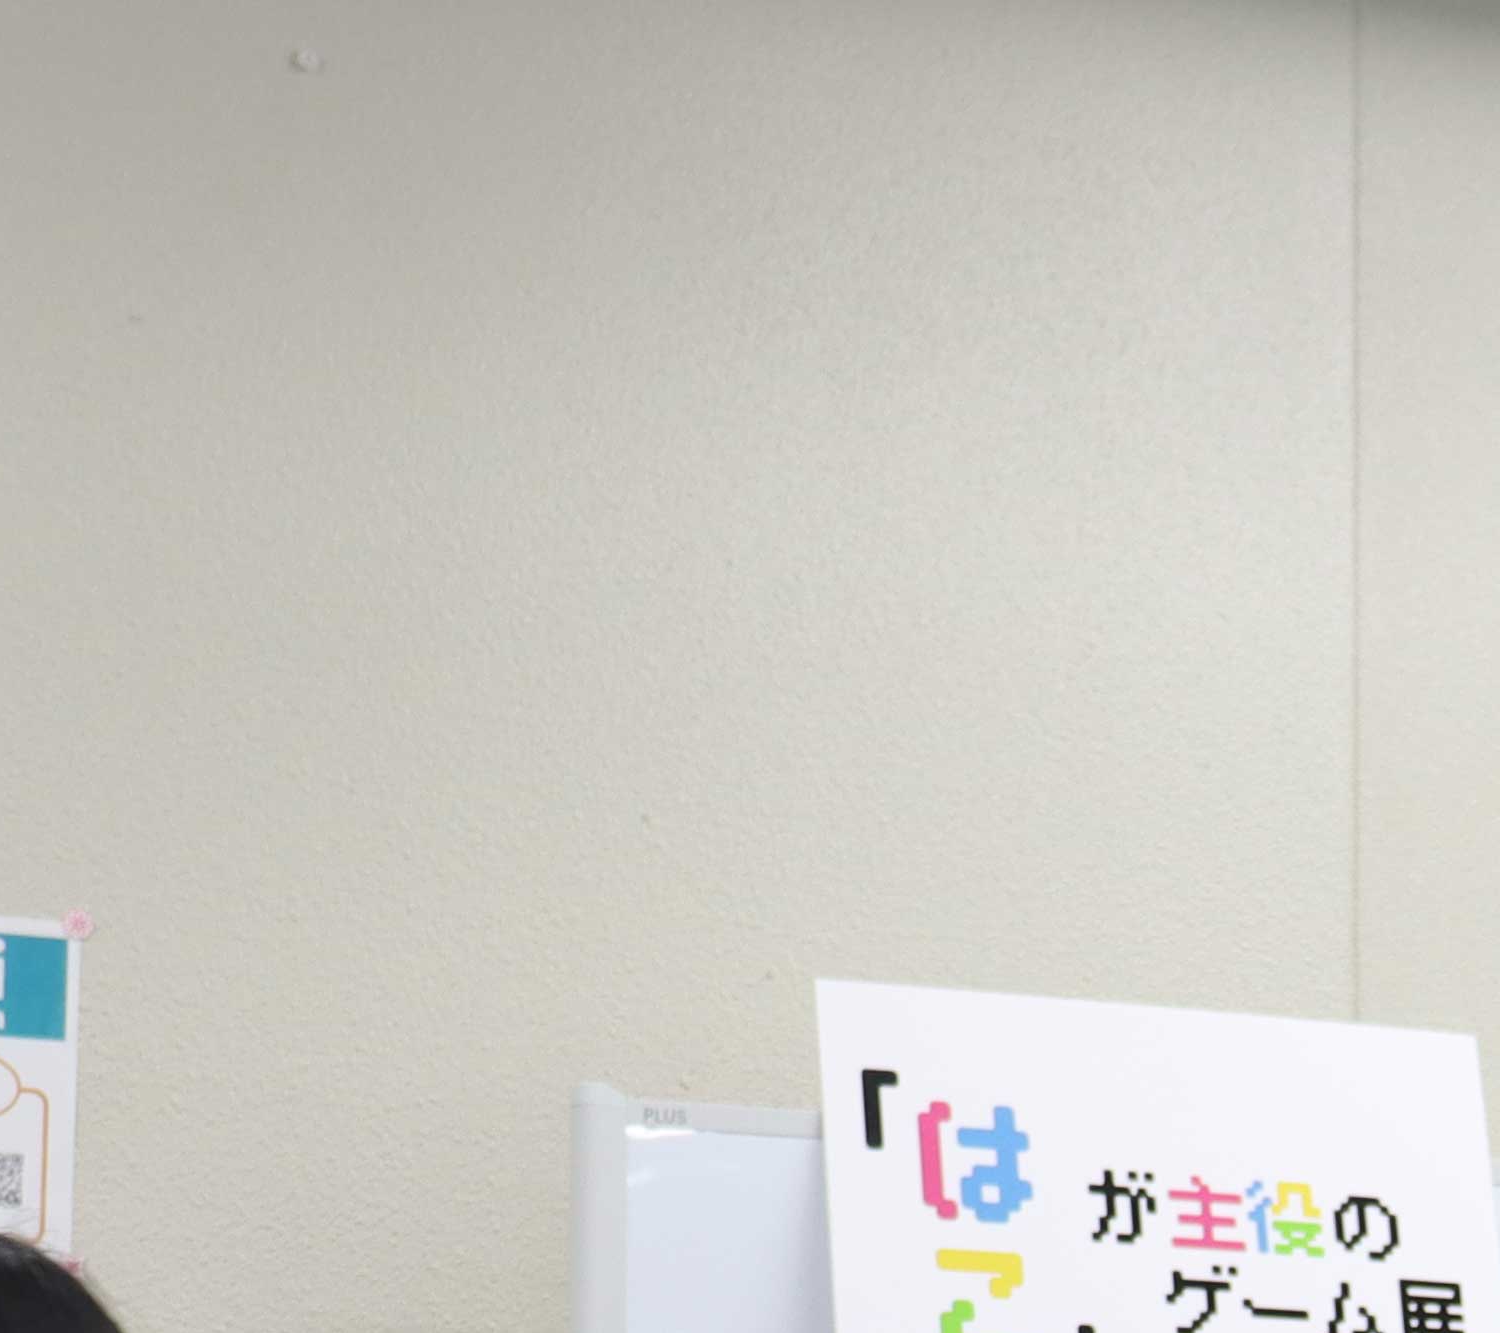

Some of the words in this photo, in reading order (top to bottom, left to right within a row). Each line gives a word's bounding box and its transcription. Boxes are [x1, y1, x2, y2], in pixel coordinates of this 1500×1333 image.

[642, 1107, 688, 1126] PLUS
[1088, 1169, 1400, 1261] が主役の
